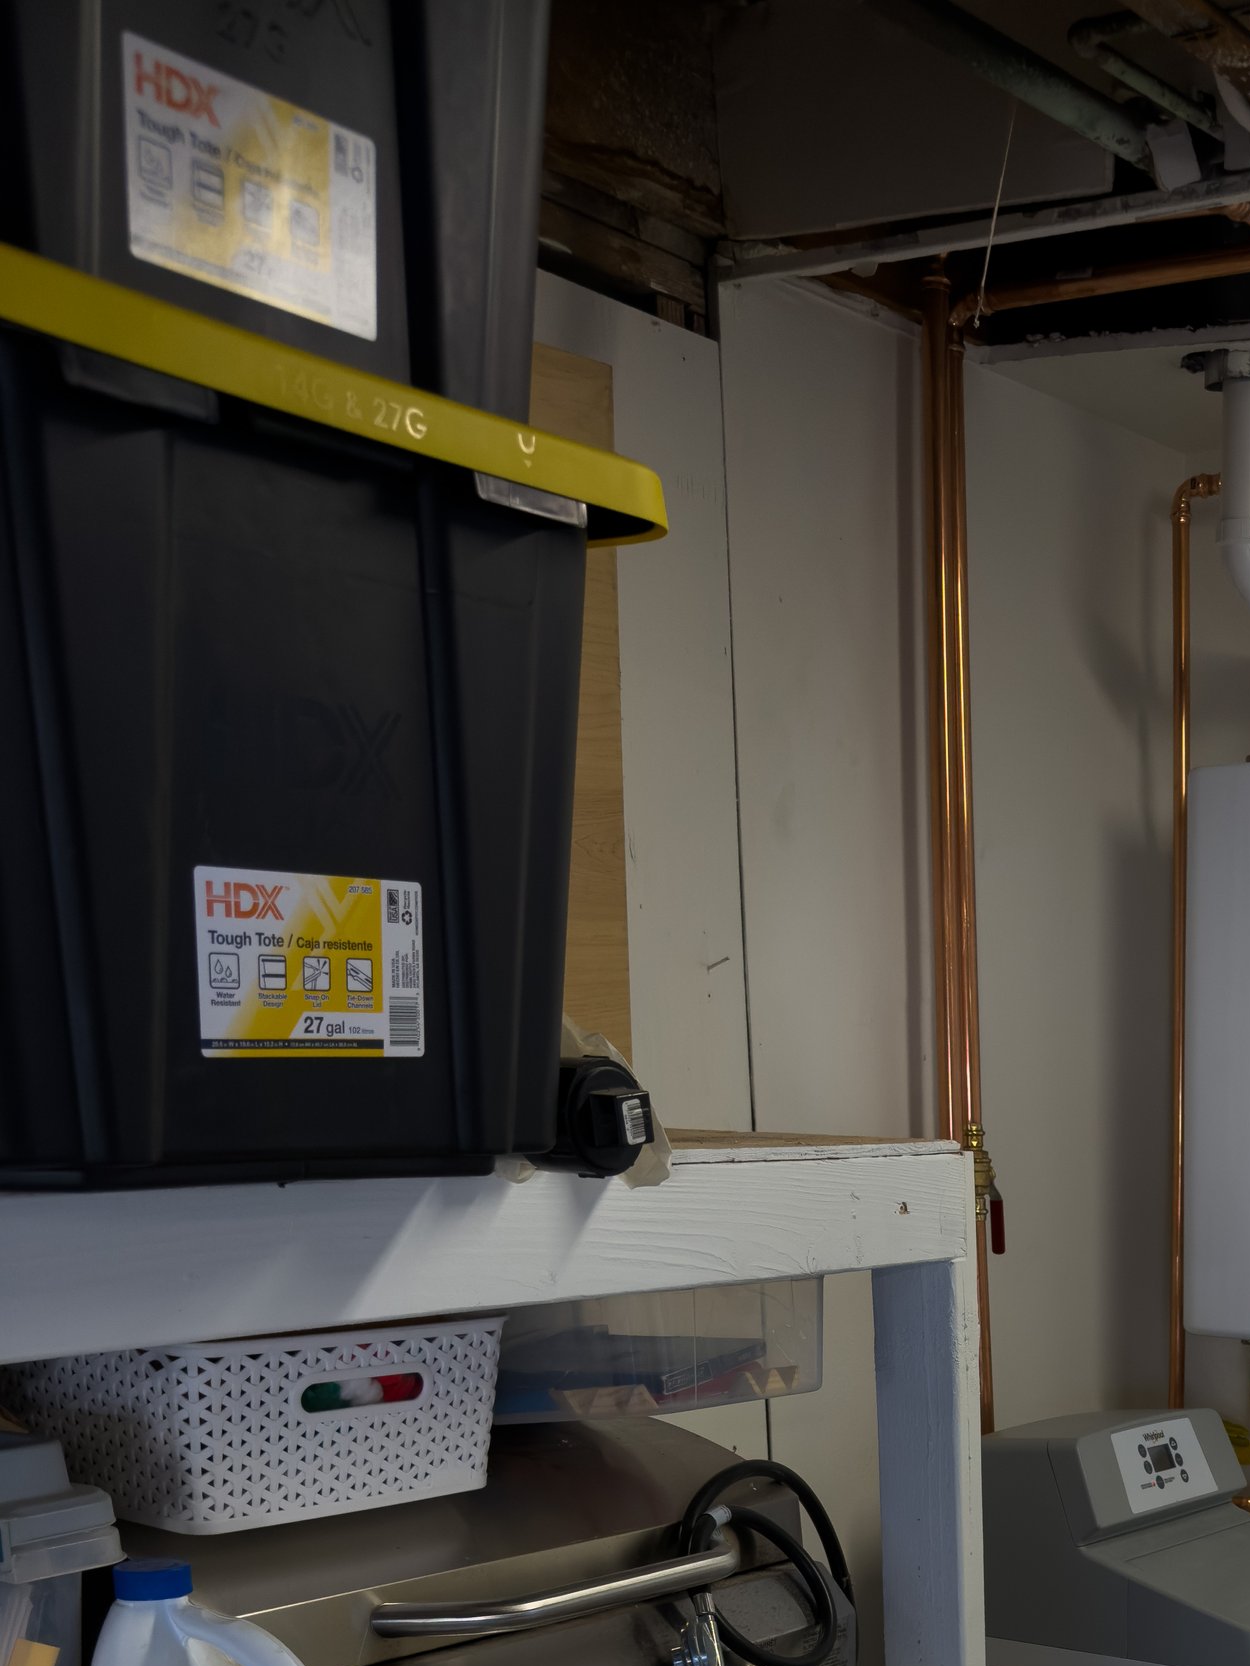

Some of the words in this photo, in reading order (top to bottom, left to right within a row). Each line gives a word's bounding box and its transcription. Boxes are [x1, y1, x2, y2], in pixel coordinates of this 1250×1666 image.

[133, 50, 222, 129] HDX
[374, 399, 427, 440] 27G
[205, 880, 285, 921] HDX
[208, 930, 252, 949] Tough
[256, 932, 284, 948] Tote
[296, 937, 320, 951] Caja
[323, 938, 373, 951] resistente
[211, 999, 241, 1007] Resistant
[216, 991, 235, 999] Water
[263, 1000, 284, 1008] Design
[304, 994, 318, 1002] Snap
[304, 1016, 324, 1034] 27
[326, 1020, 345, 1038] gal
[349, 1026, 361, 1034] 102
